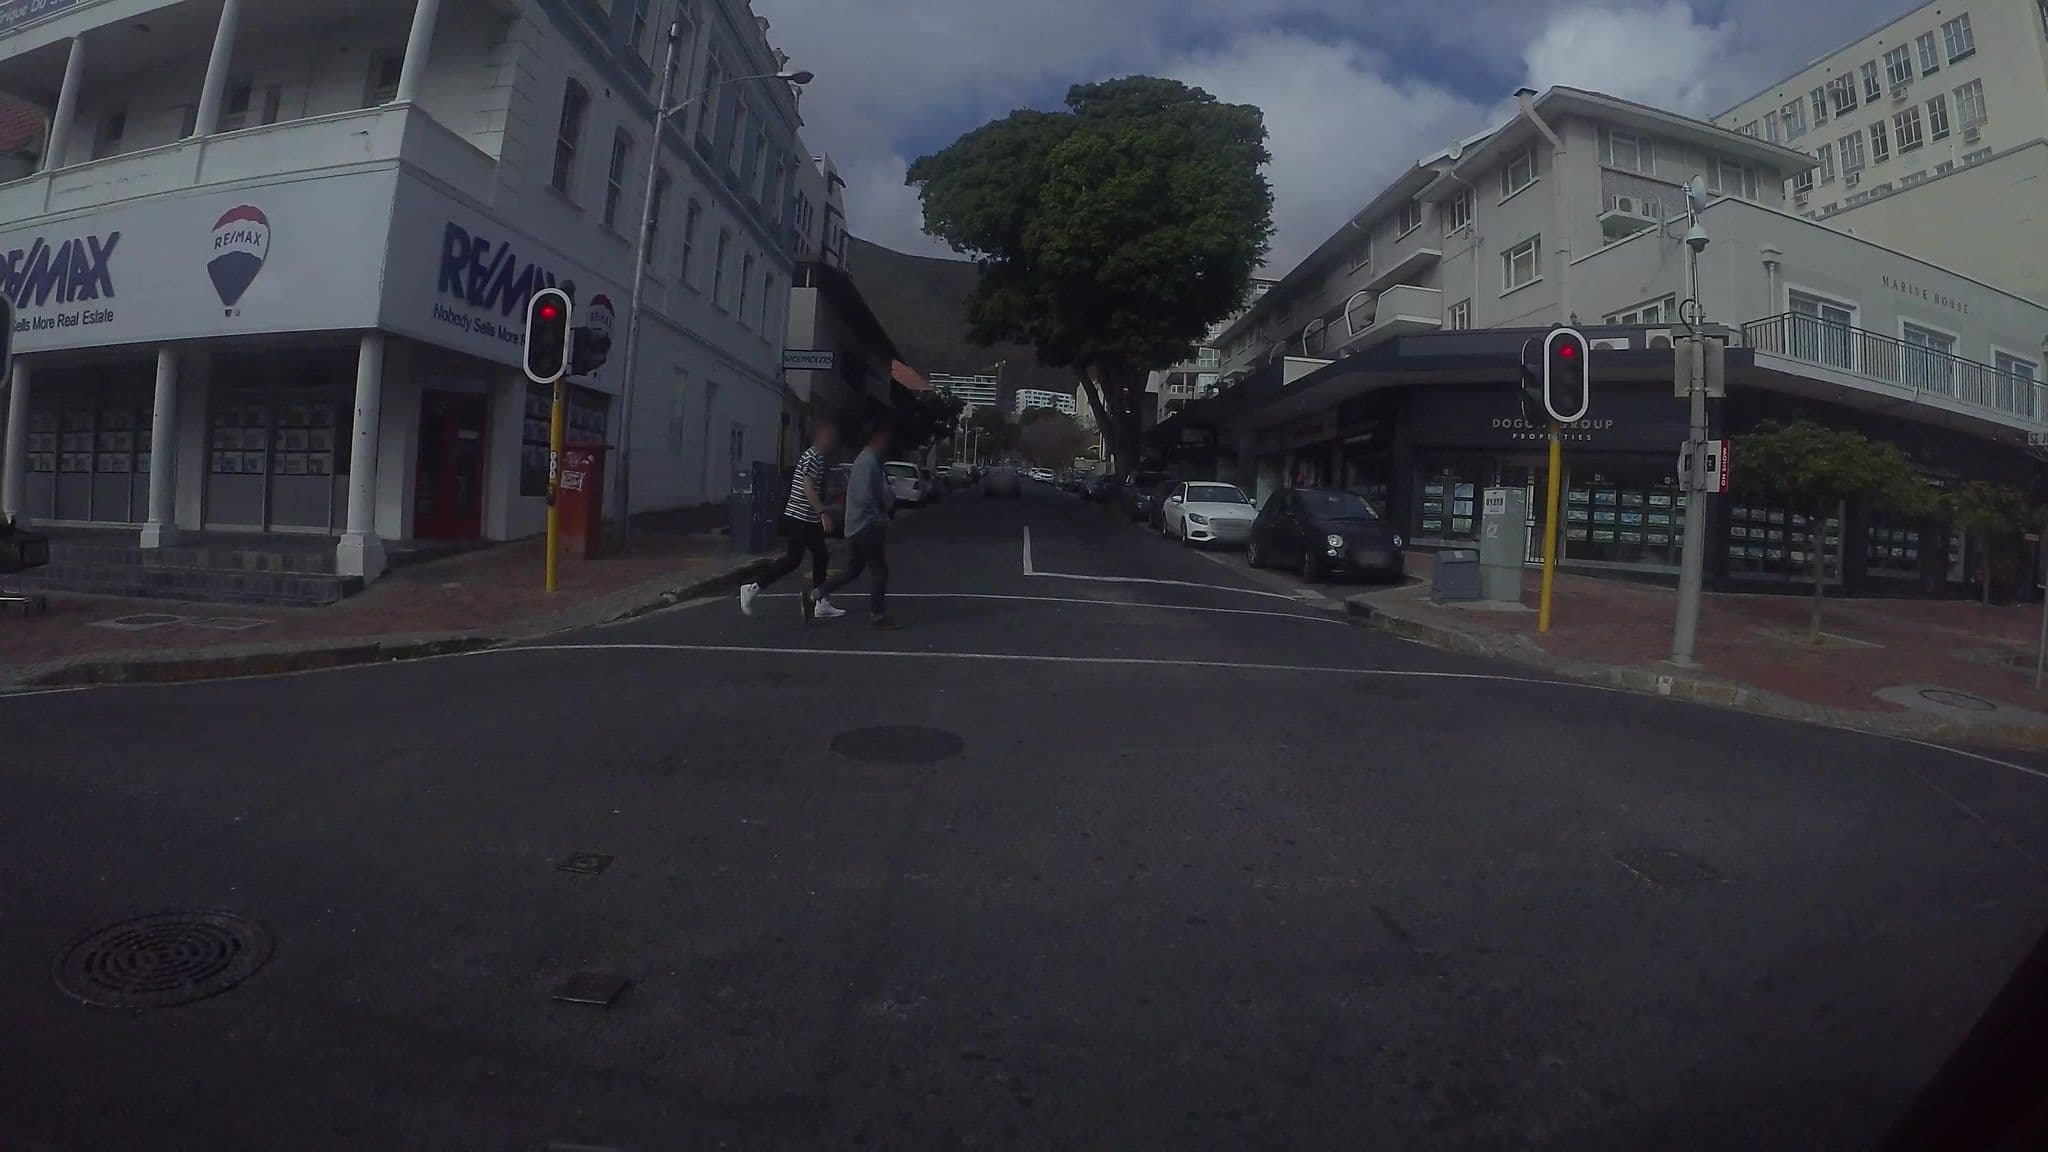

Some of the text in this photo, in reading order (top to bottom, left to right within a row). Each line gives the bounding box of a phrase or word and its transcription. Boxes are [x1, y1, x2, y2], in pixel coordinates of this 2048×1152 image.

[214, 230, 262, 250] RE/MAX
[32, 316, 55, 331] More
[57, 312, 80, 328] Real
[82, 308, 114, 325] Estate
[434, 303, 472, 332] Nobody
[474, 319, 496, 337] Sells
[497, 328, 519, 345] More
[1720, 474, 1727, 486] ON
